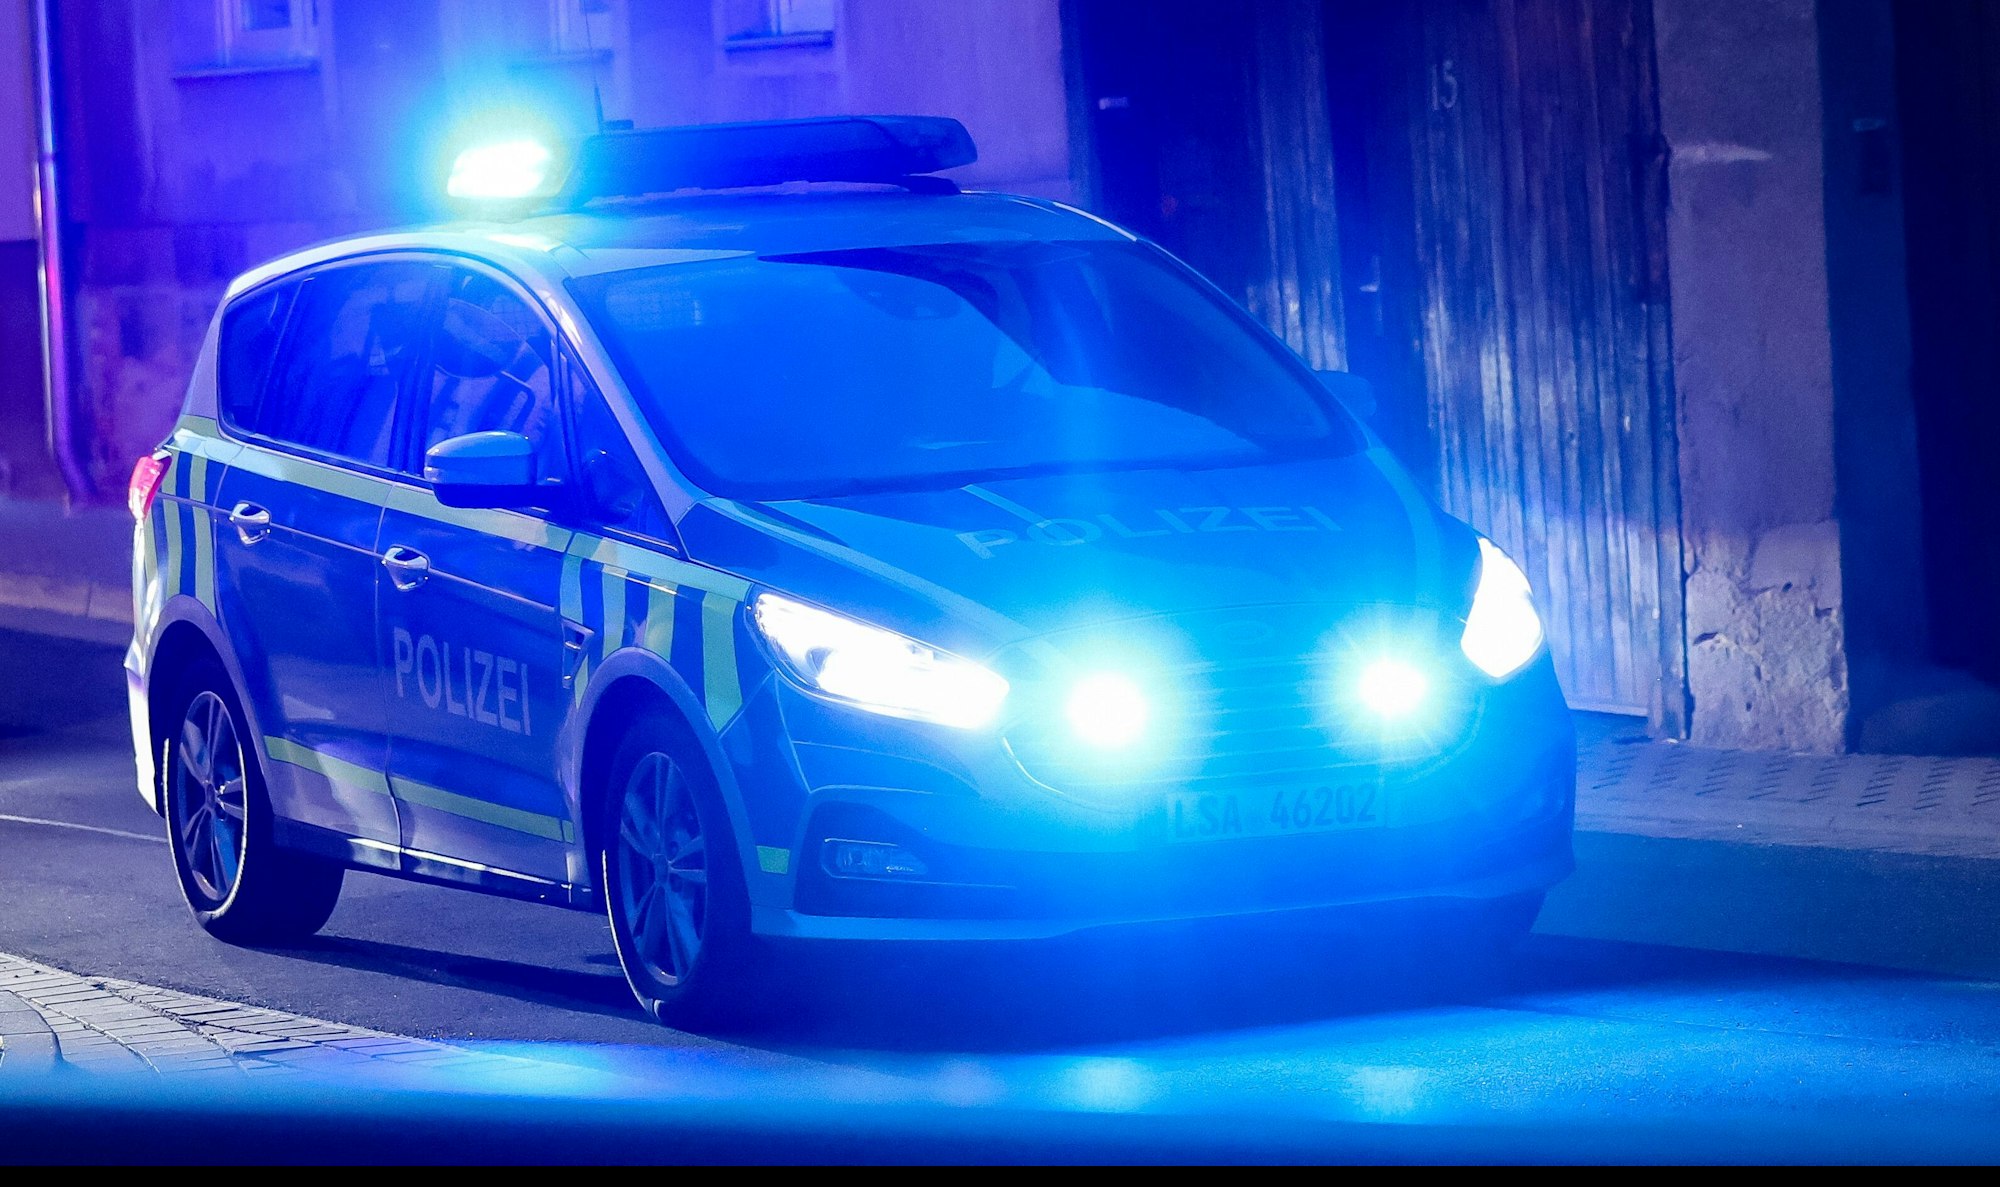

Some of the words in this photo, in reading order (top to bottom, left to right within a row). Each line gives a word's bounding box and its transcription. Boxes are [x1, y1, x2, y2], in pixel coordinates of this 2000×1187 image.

[1431, 61, 1457, 111] 15
[956, 506, 1342, 559] POLIZEI
[393, 626, 531, 736] POLIZEI
[1175, 794, 1242, 838] LSA
[1269, 783, 1377, 829] 46202
